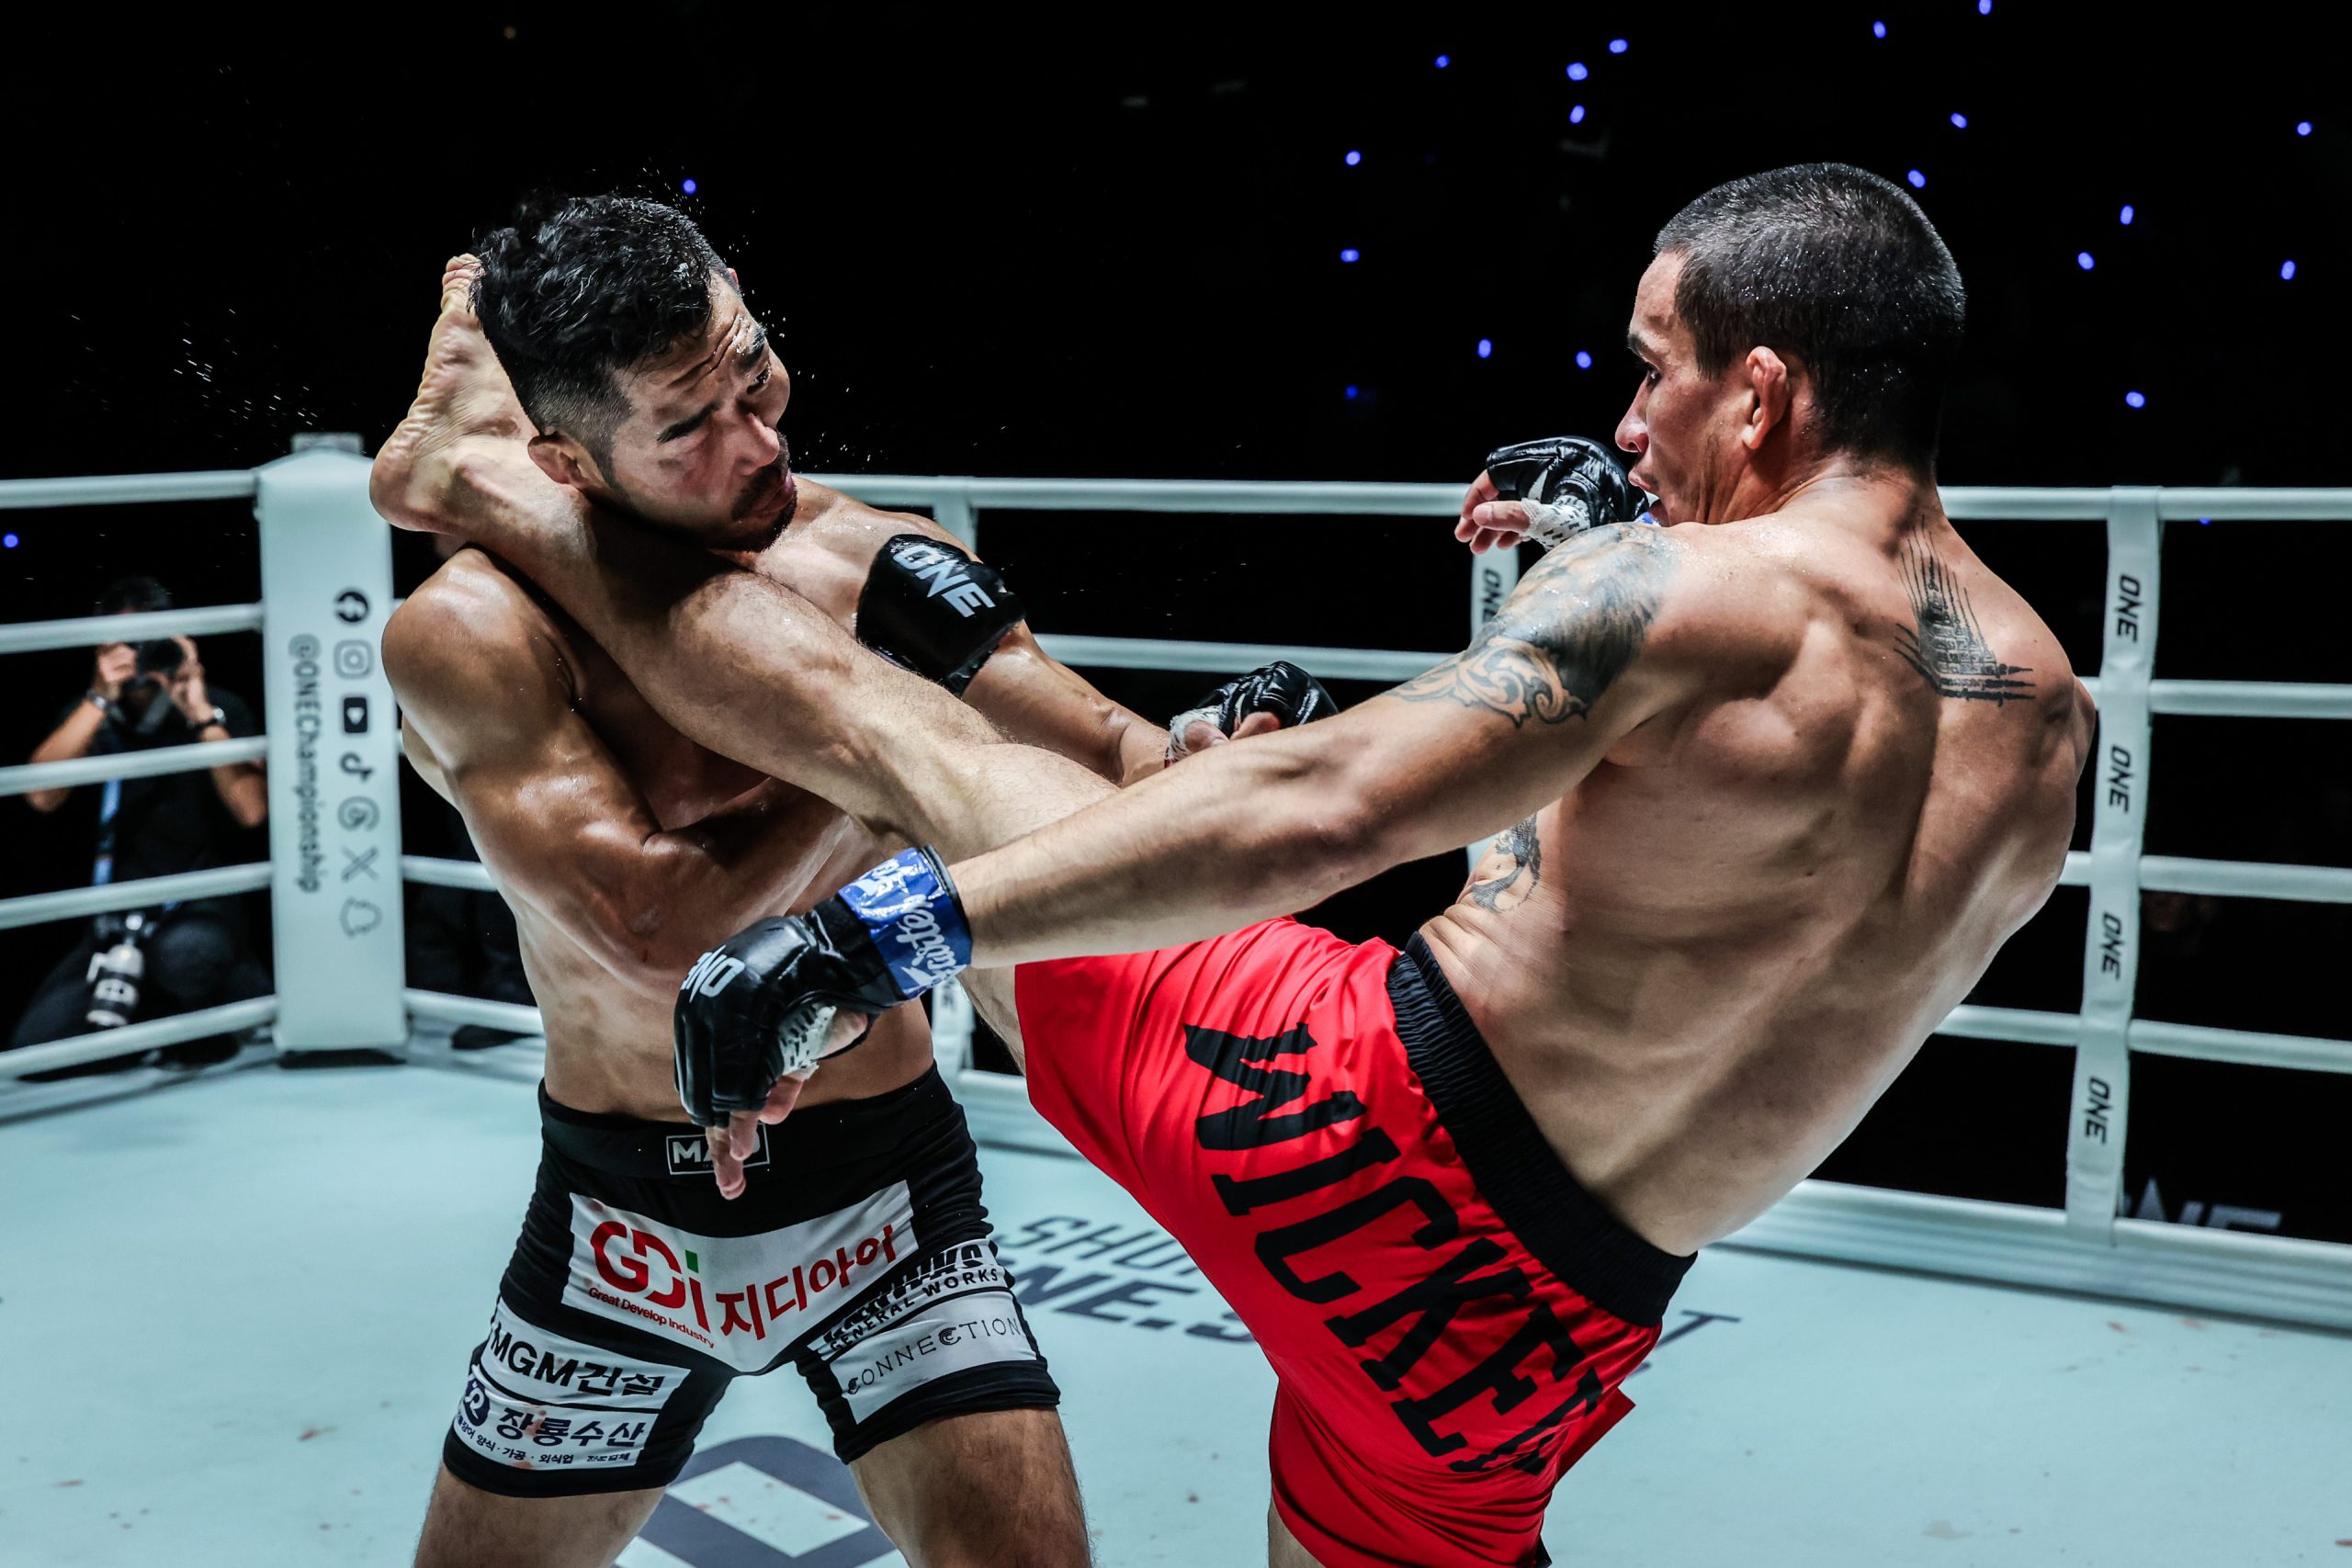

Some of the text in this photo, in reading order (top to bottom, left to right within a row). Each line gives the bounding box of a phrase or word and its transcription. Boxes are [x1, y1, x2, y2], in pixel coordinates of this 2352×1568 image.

[892, 542, 997, 618] ONE
[2116, 574, 2142, 643] ONE
[288, 634, 325, 894] @ONEChampionship
[2109, 745, 2132, 813] ONE
[2101, 912, 2124, 980] ONE
[2085, 1076, 2112, 1145] ONE
[715, 1224, 897, 1340] 지디아이
[829, 1298, 915, 1352] GENERAL
[922, 1268, 999, 1297] WORKS
[587, 1286, 714, 1348] Great Develop Industry
[491, 1321, 666, 1396] MGM건설
[847, 1317, 1022, 1395] CONNECTION
[477, 1435, 496, 1451] 양식
[502, 1447, 526, 1461] 가공
[538, 1454, 574, 1464] 외식업
[496, 1407, 646, 1447] 장룡수산
